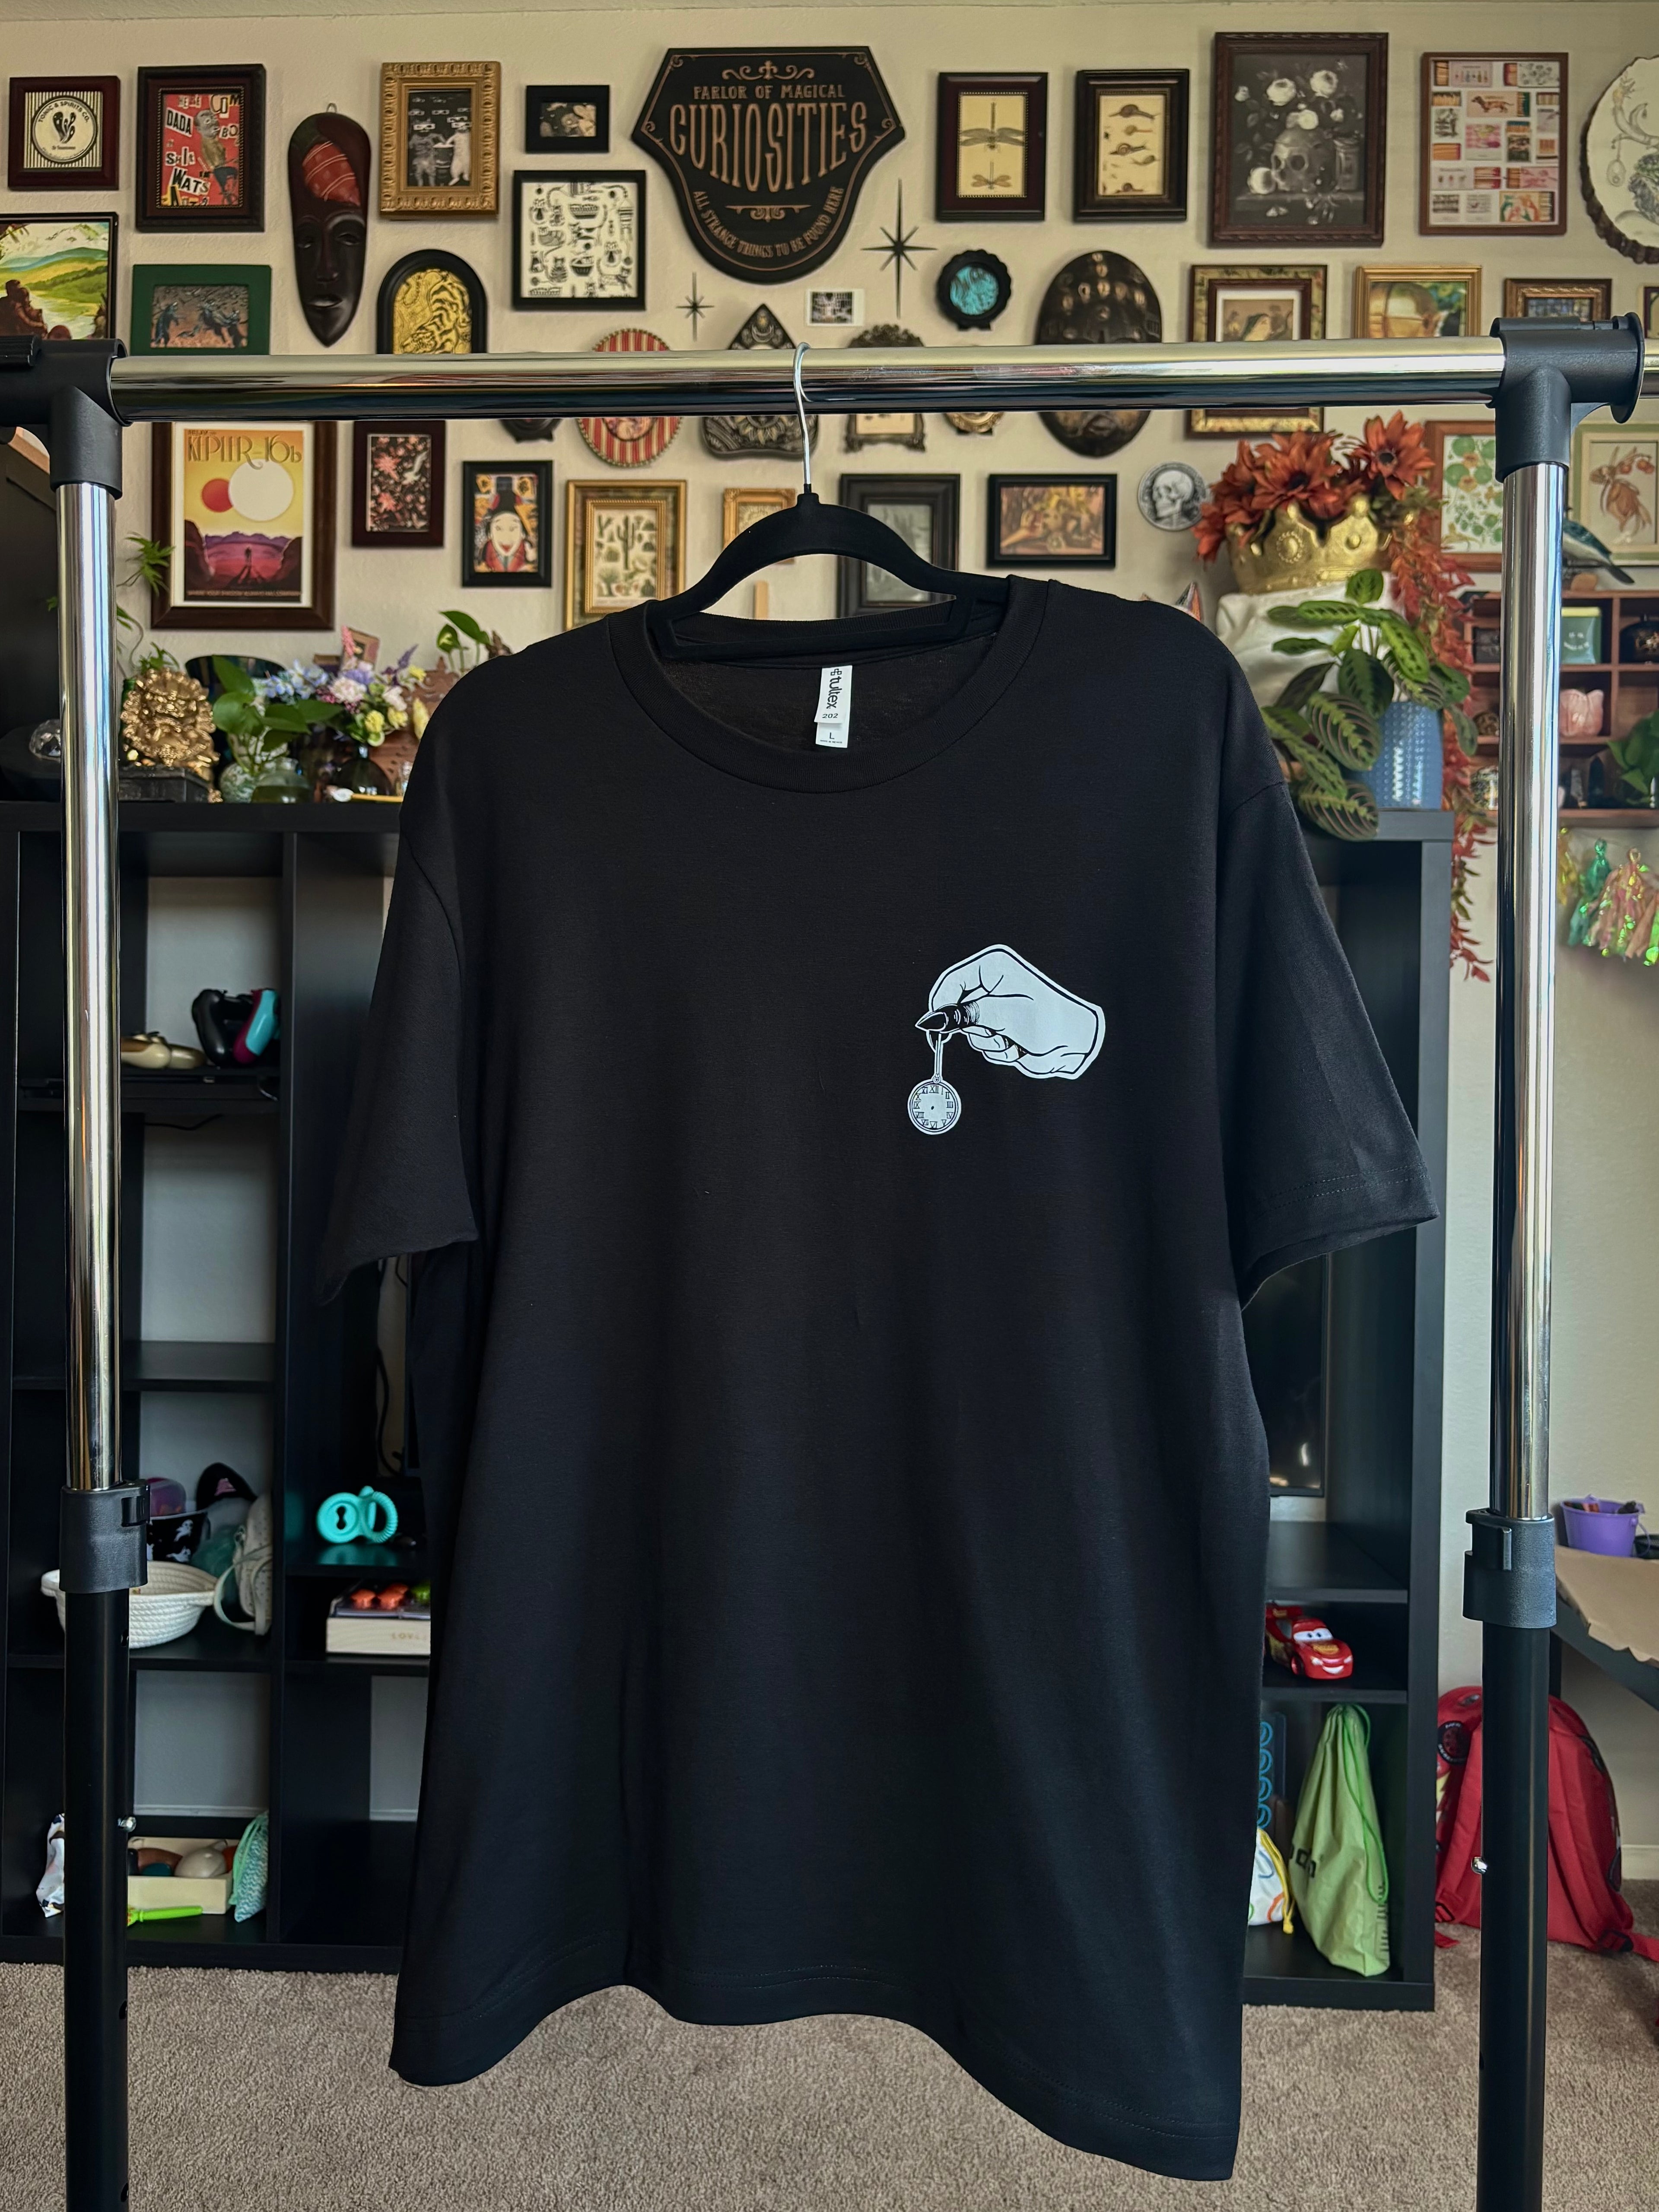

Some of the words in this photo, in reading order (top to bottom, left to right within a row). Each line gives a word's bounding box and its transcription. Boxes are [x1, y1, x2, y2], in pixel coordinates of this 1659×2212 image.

[693, 86, 748, 99] PARLOR
[755, 86, 773, 99] OF
[780, 84, 845, 99] MAGICAL
[38, 105, 54, 122] TONIC
[60, 101, 83, 112] SPIRITS
[167, 110, 191, 134] DADA
[670, 102, 867, 192] CURIOSITIES
[172, 168, 209, 193] WATS
[693, 191, 710, 210] ALL
[823, 186, 844, 214] HERE
[701, 210, 739, 249] STRANGE
[802, 214, 832, 245] FOUND
[737, 240, 773, 257] THINGS
[774, 242, 790, 257] TO
[790, 237, 807, 252] BE
[826, 676, 842, 709] tultex
